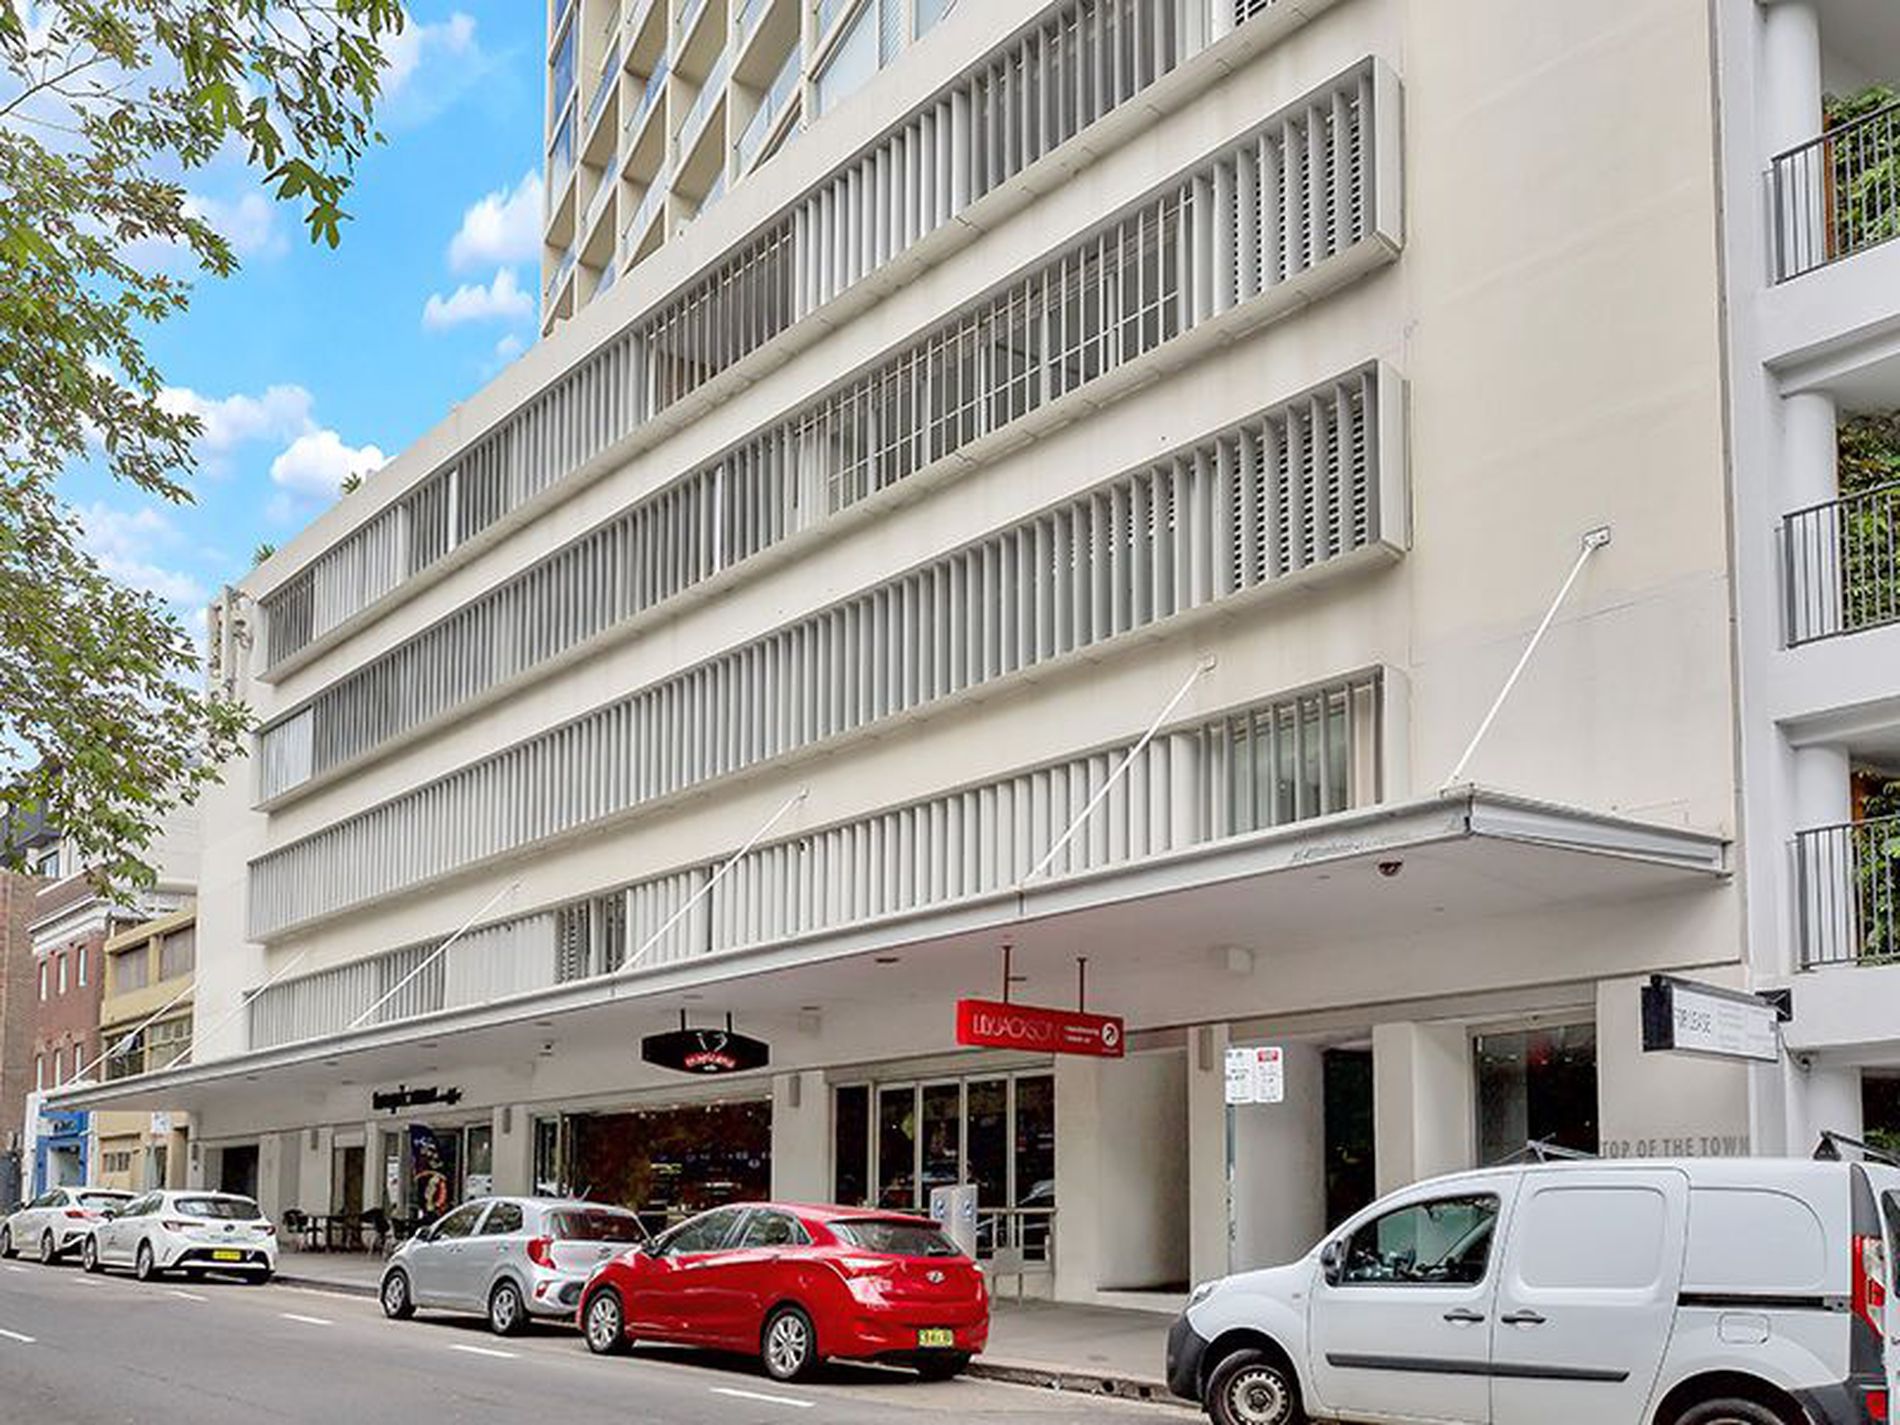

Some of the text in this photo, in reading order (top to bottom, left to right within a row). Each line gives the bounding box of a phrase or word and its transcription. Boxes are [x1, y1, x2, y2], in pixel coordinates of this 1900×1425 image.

[1600, 1135, 1750, 1159] TOP OF THE TOWN
